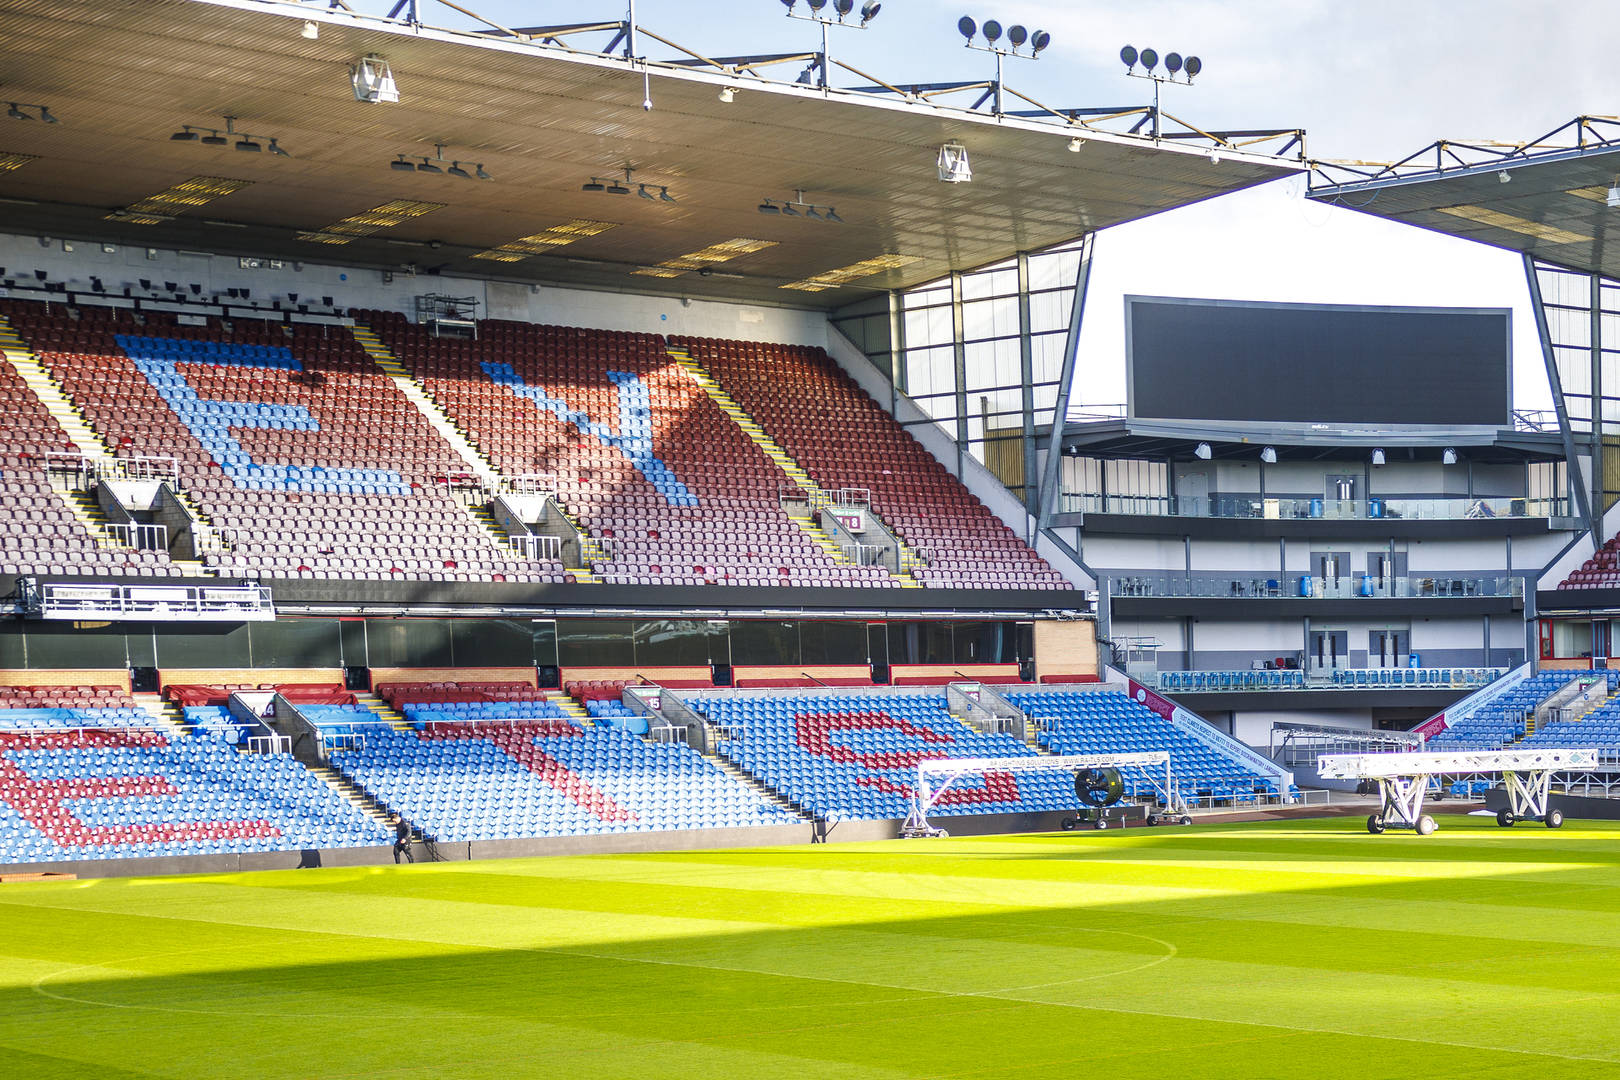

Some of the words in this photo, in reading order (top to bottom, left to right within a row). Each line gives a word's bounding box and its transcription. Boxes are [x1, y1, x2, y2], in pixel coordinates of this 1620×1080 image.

[851, 517, 858, 528] 8
[648, 697, 660, 709] 15
[1026, 758, 1060, 766] SOLUTIONS
